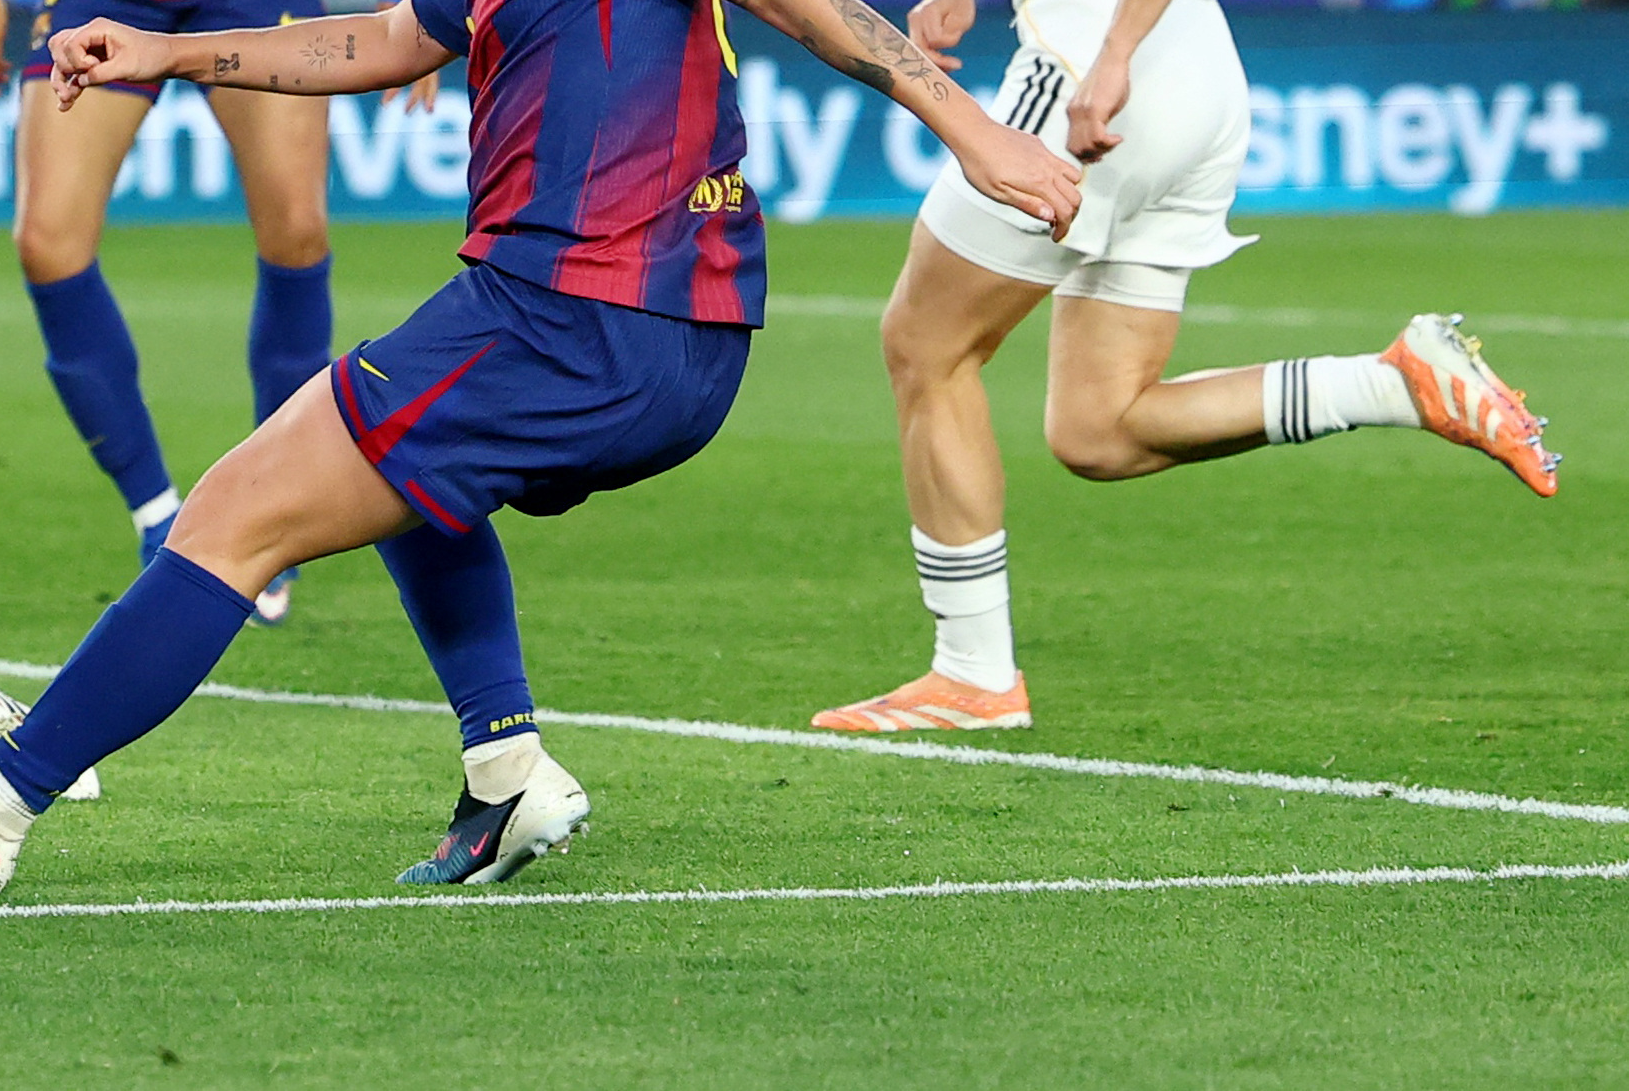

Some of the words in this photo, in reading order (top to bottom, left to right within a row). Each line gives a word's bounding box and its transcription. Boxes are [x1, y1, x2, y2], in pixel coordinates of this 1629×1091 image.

[328, 87, 472, 198] ve
[739, 57, 862, 223] ly
[1237, 81, 1609, 215] sney+
